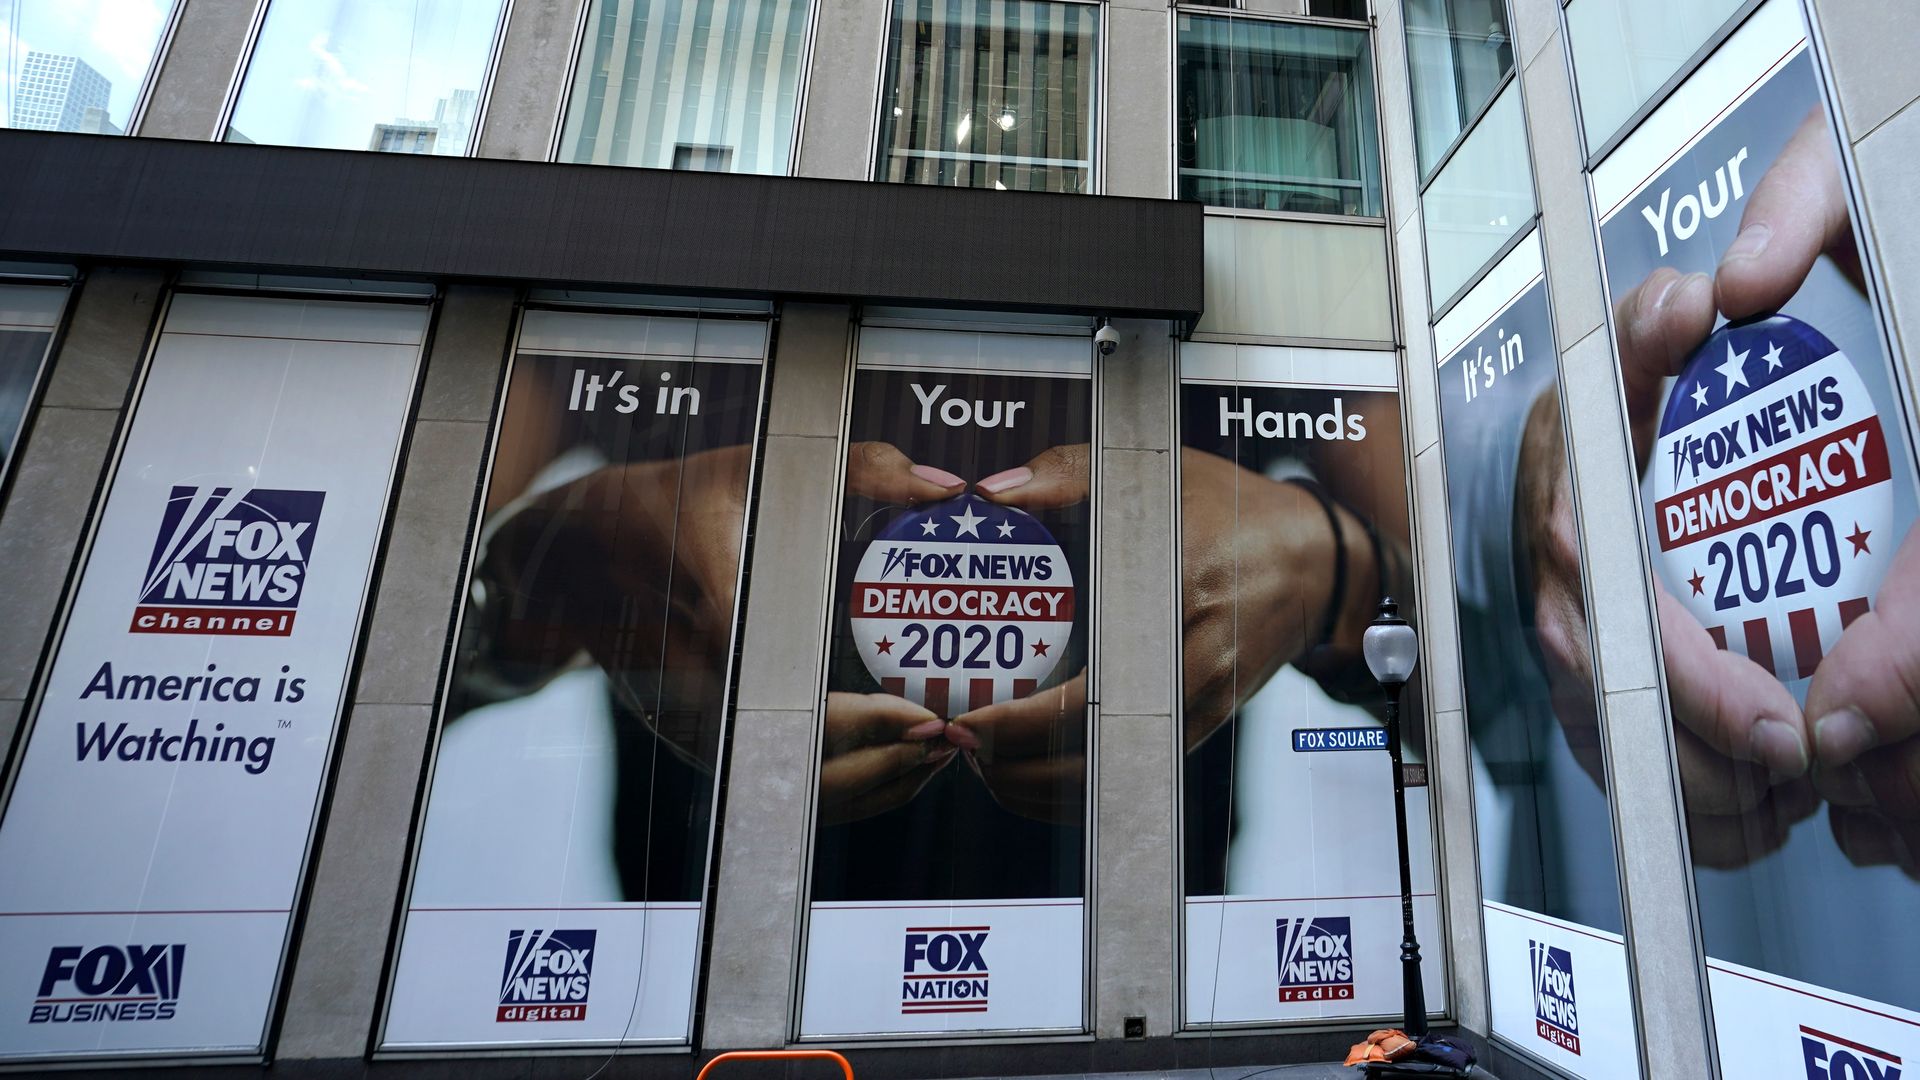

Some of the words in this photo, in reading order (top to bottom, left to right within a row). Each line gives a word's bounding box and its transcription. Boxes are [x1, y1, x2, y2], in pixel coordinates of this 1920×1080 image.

[1641, 146, 1748, 257] Your
[1498, 328, 1524, 376] in
[656, 371, 700, 416] in
[910, 383, 1026, 428] Your
[1219, 397, 1366, 441] Hands
[1688, 420, 1746, 478] FOX
[1746, 376, 1843, 453] NEWS
[1665, 430, 1870, 542] DEMOCRACY
[206, 519, 311, 561] FOX
[904, 552, 963, 579] FOX
[968, 555, 1053, 581] NEWS
[1707, 510, 1841, 611] 2020
[163, 562, 301, 603] NEWS
[137, 612, 288, 631] channel
[862, 588, 1065, 617] DEMOCRACY
[899, 623, 1024, 670] 2020
[79, 661, 261, 702] America
[274, 663, 307, 703] is
[76, 719, 276, 775] Watching
[1299, 732, 1325, 748] FOX
[1329, 730, 1385, 748] SQUARE
[532, 949, 591, 975] FOX
[904, 933, 989, 972] FOX
[1301, 934, 1350, 959] FOX
[37, 944, 169, 997] FOX
[512, 976, 587, 1001] NEWS
[902, 980, 989, 1000] NATION
[1289, 959, 1351, 983] NEWS
[1544, 965, 1574, 1002] FOX
[28, 1002, 178, 1024] BUSINESS
[1285, 987, 1349, 1000] radio
[1538, 991, 1577, 1031] NEWS
[504, 1006, 580, 1021] digital
[1540, 1024, 1577, 1051] digital
